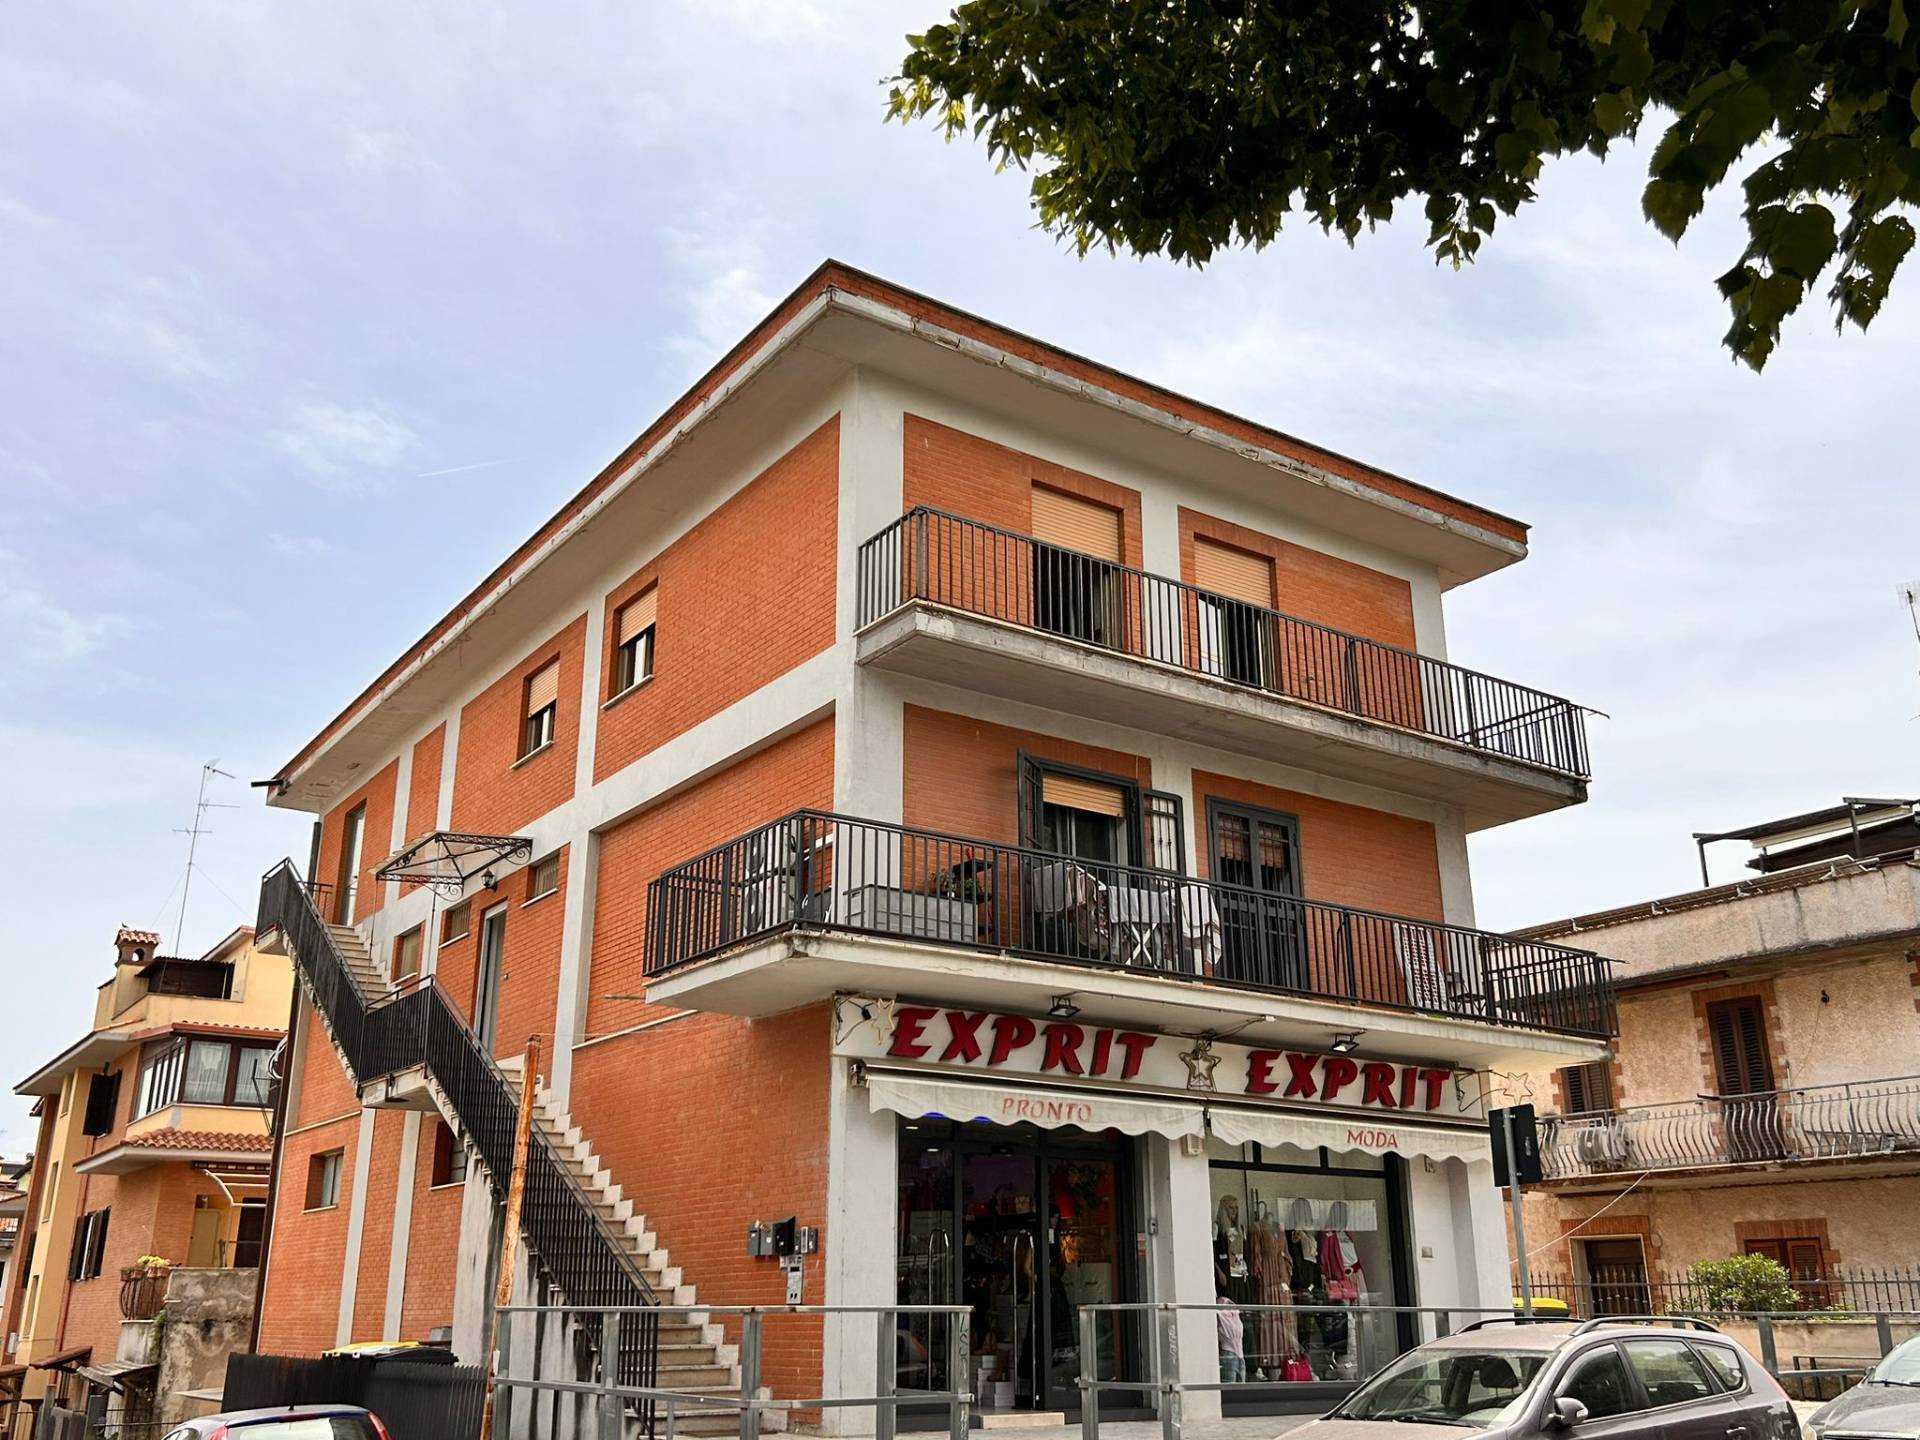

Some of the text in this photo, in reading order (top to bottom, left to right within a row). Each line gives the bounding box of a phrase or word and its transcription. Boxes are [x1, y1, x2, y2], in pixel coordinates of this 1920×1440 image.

[887, 1007, 1158, 1080] EXPRIT
[1244, 1050, 1451, 1111] EXPRIT
[1002, 1097, 1092, 1122] PRONTO
[1347, 1129, 1398, 1148] MODA
